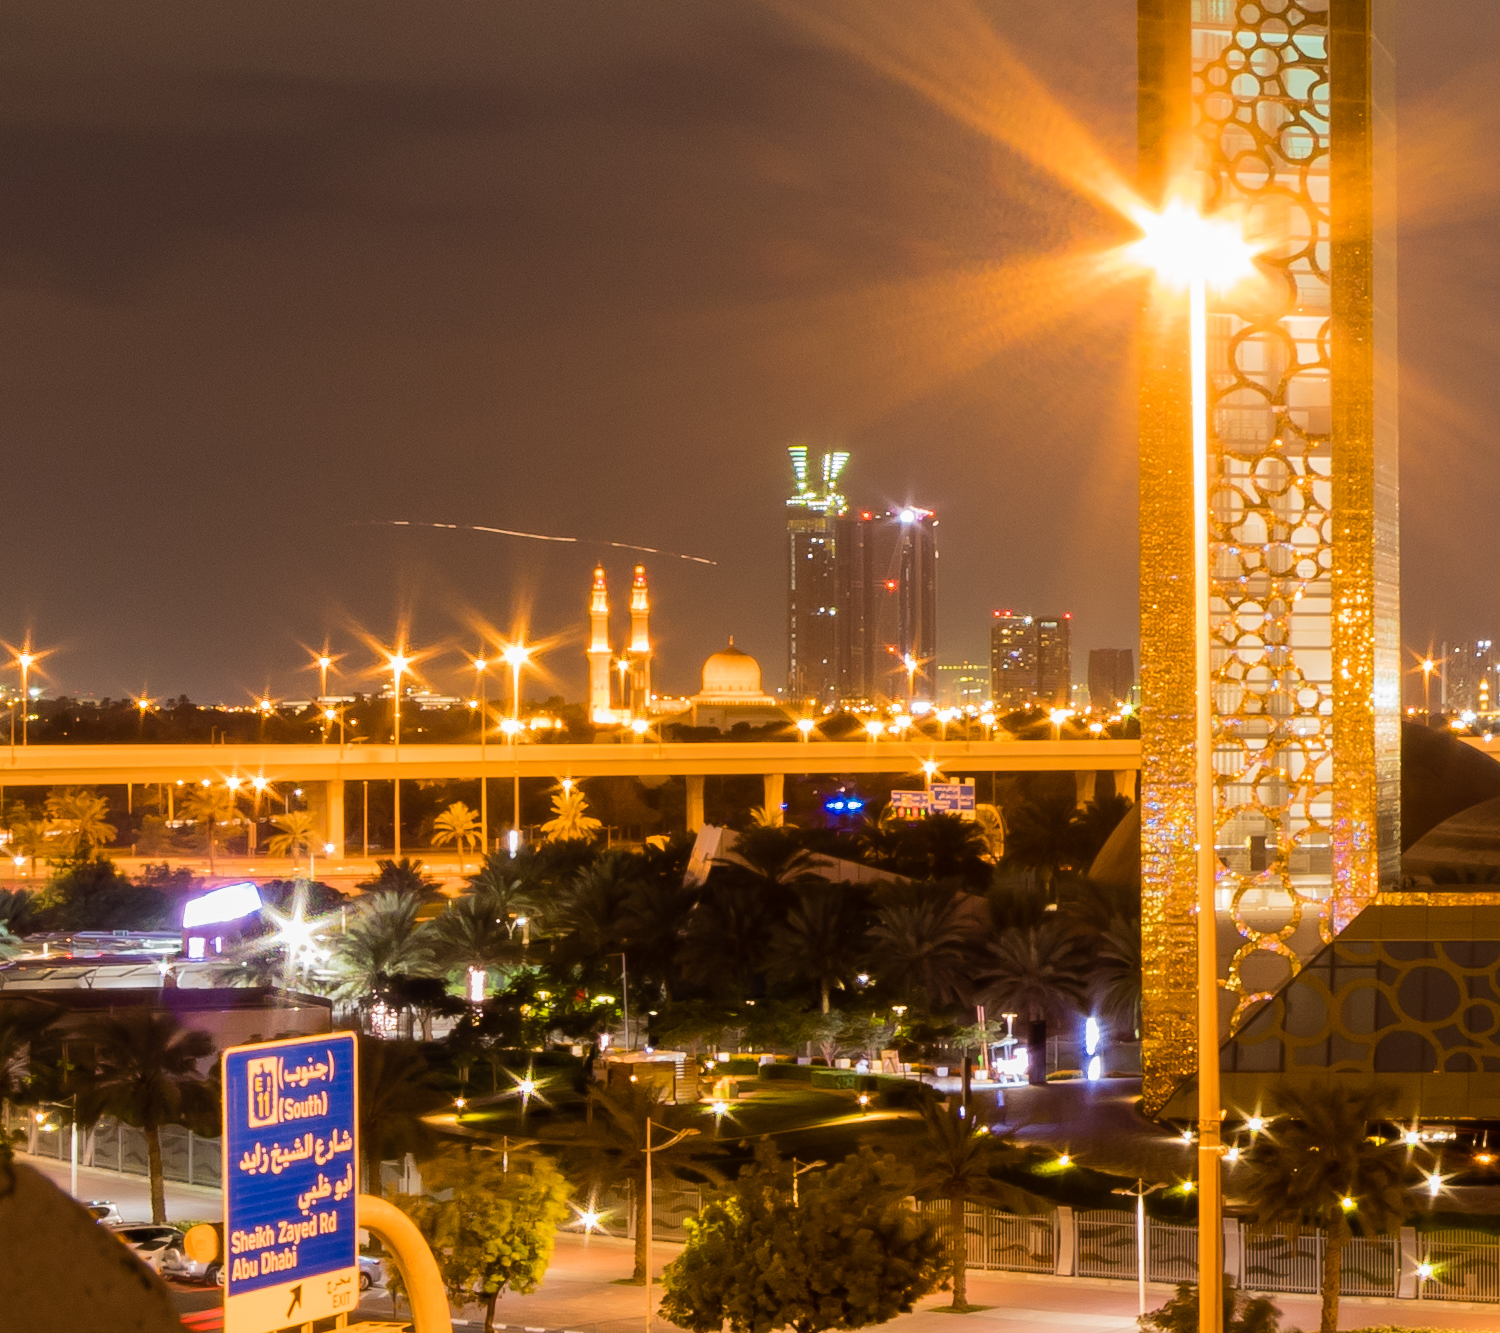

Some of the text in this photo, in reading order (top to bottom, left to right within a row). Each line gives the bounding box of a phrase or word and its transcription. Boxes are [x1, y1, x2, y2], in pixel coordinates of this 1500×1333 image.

[255, 1076, 263, 1093] E
[278, 1049, 335, 1090] (جنوب)
[257, 1092, 270, 1118] 11
[279, 1090, 328, 1123] (South)
[239, 1128, 353, 1175] شارع الشيخ زايد
[298, 1162, 353, 1216] أبو ظبي
[231, 1210, 337, 1254] Sheikh Zayed Rd
[231, 1245, 297, 1282] Abu Dhabi
[332, 1290, 351, 1308] EXIT
